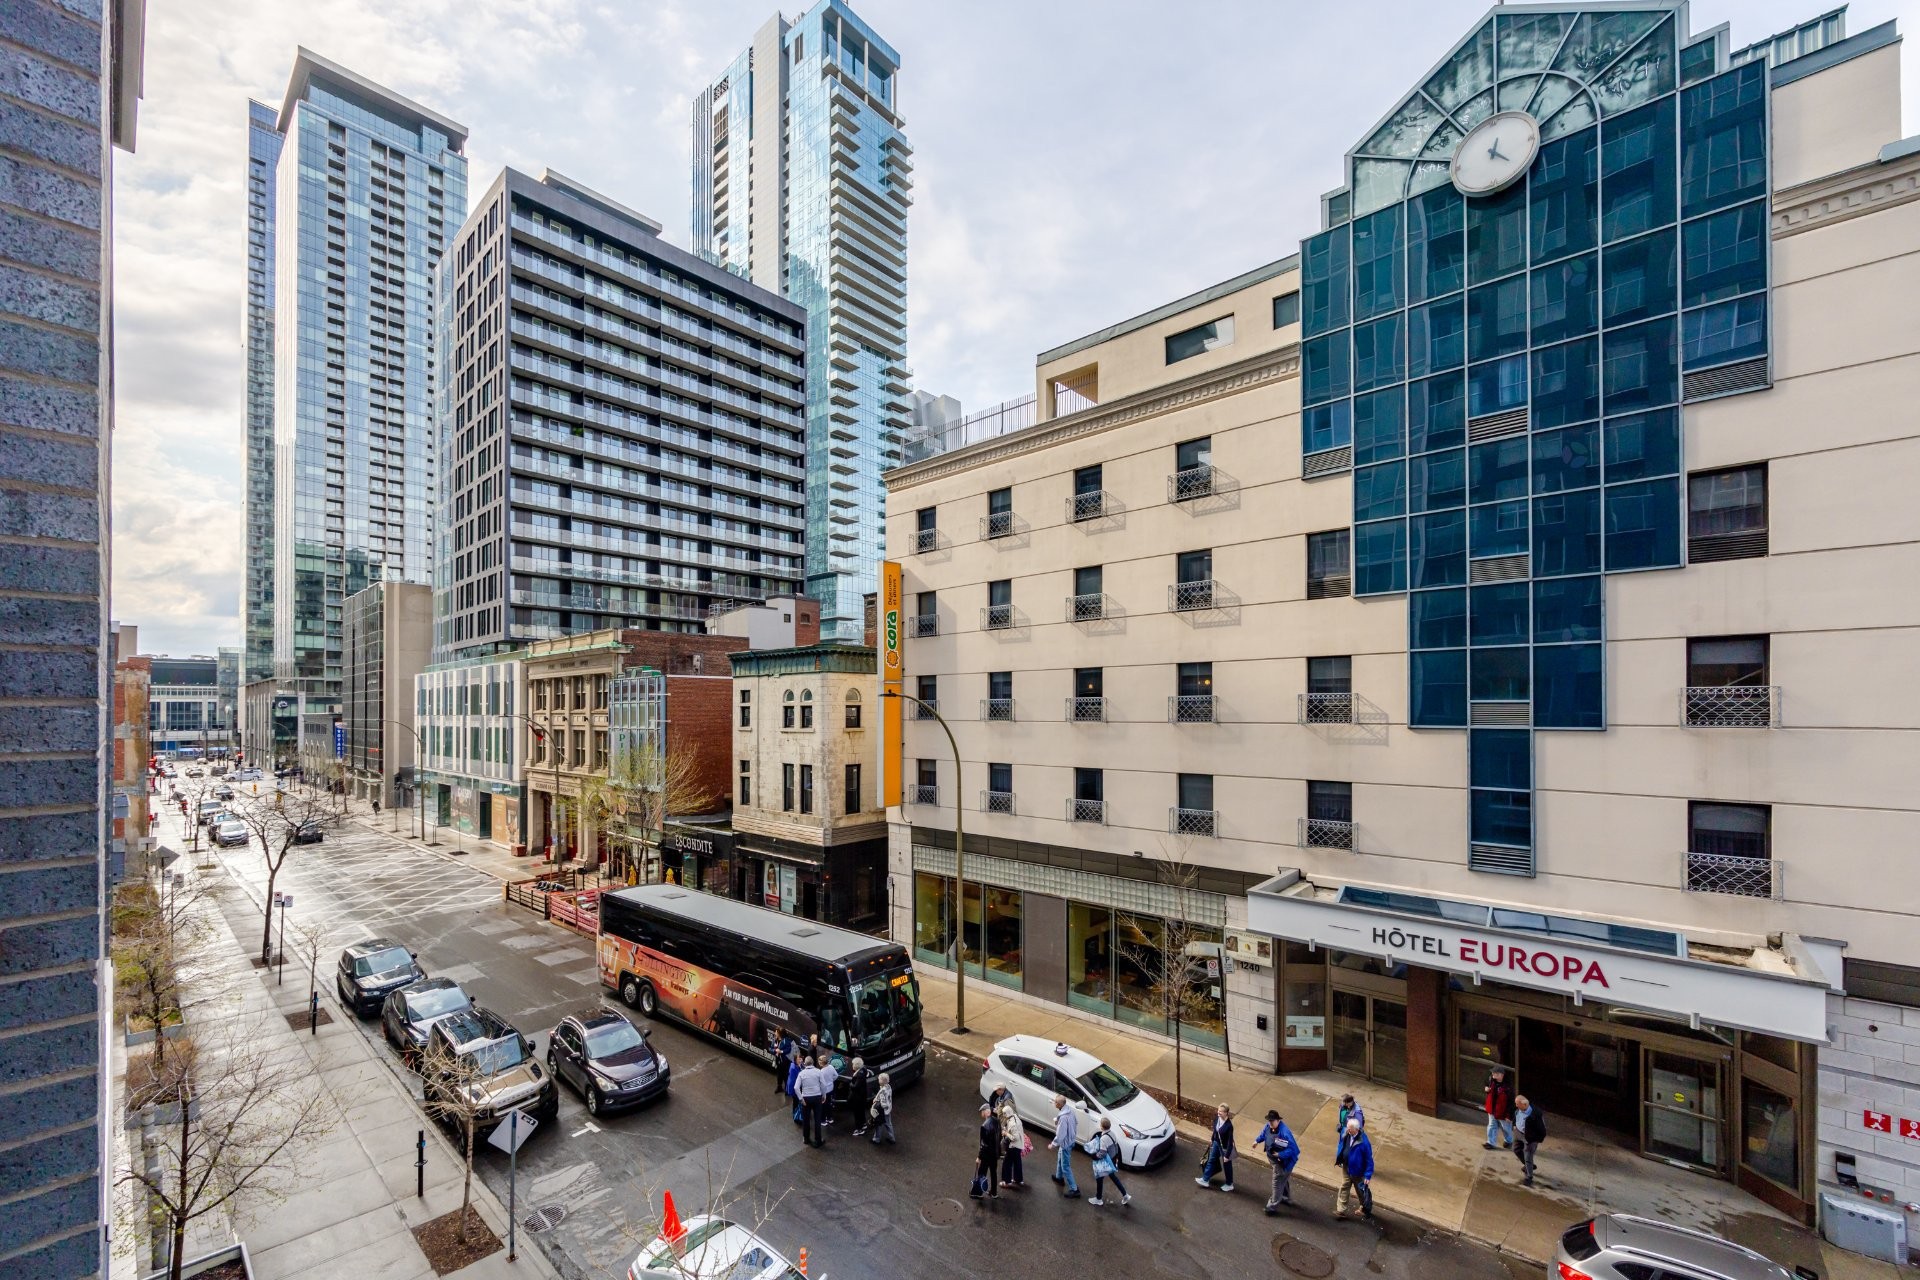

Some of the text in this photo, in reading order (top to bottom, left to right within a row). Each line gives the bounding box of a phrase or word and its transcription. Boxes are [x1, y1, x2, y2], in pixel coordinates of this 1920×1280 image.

[887, 611, 897, 650] cora
[675, 834, 714, 855] ESCONDITE
[1240, 961, 1260, 973] 1240
[1460, 938, 1610, 988] EUROPA
[828, 984, 841, 994] 1252
[849, 983, 863, 994] 1252
